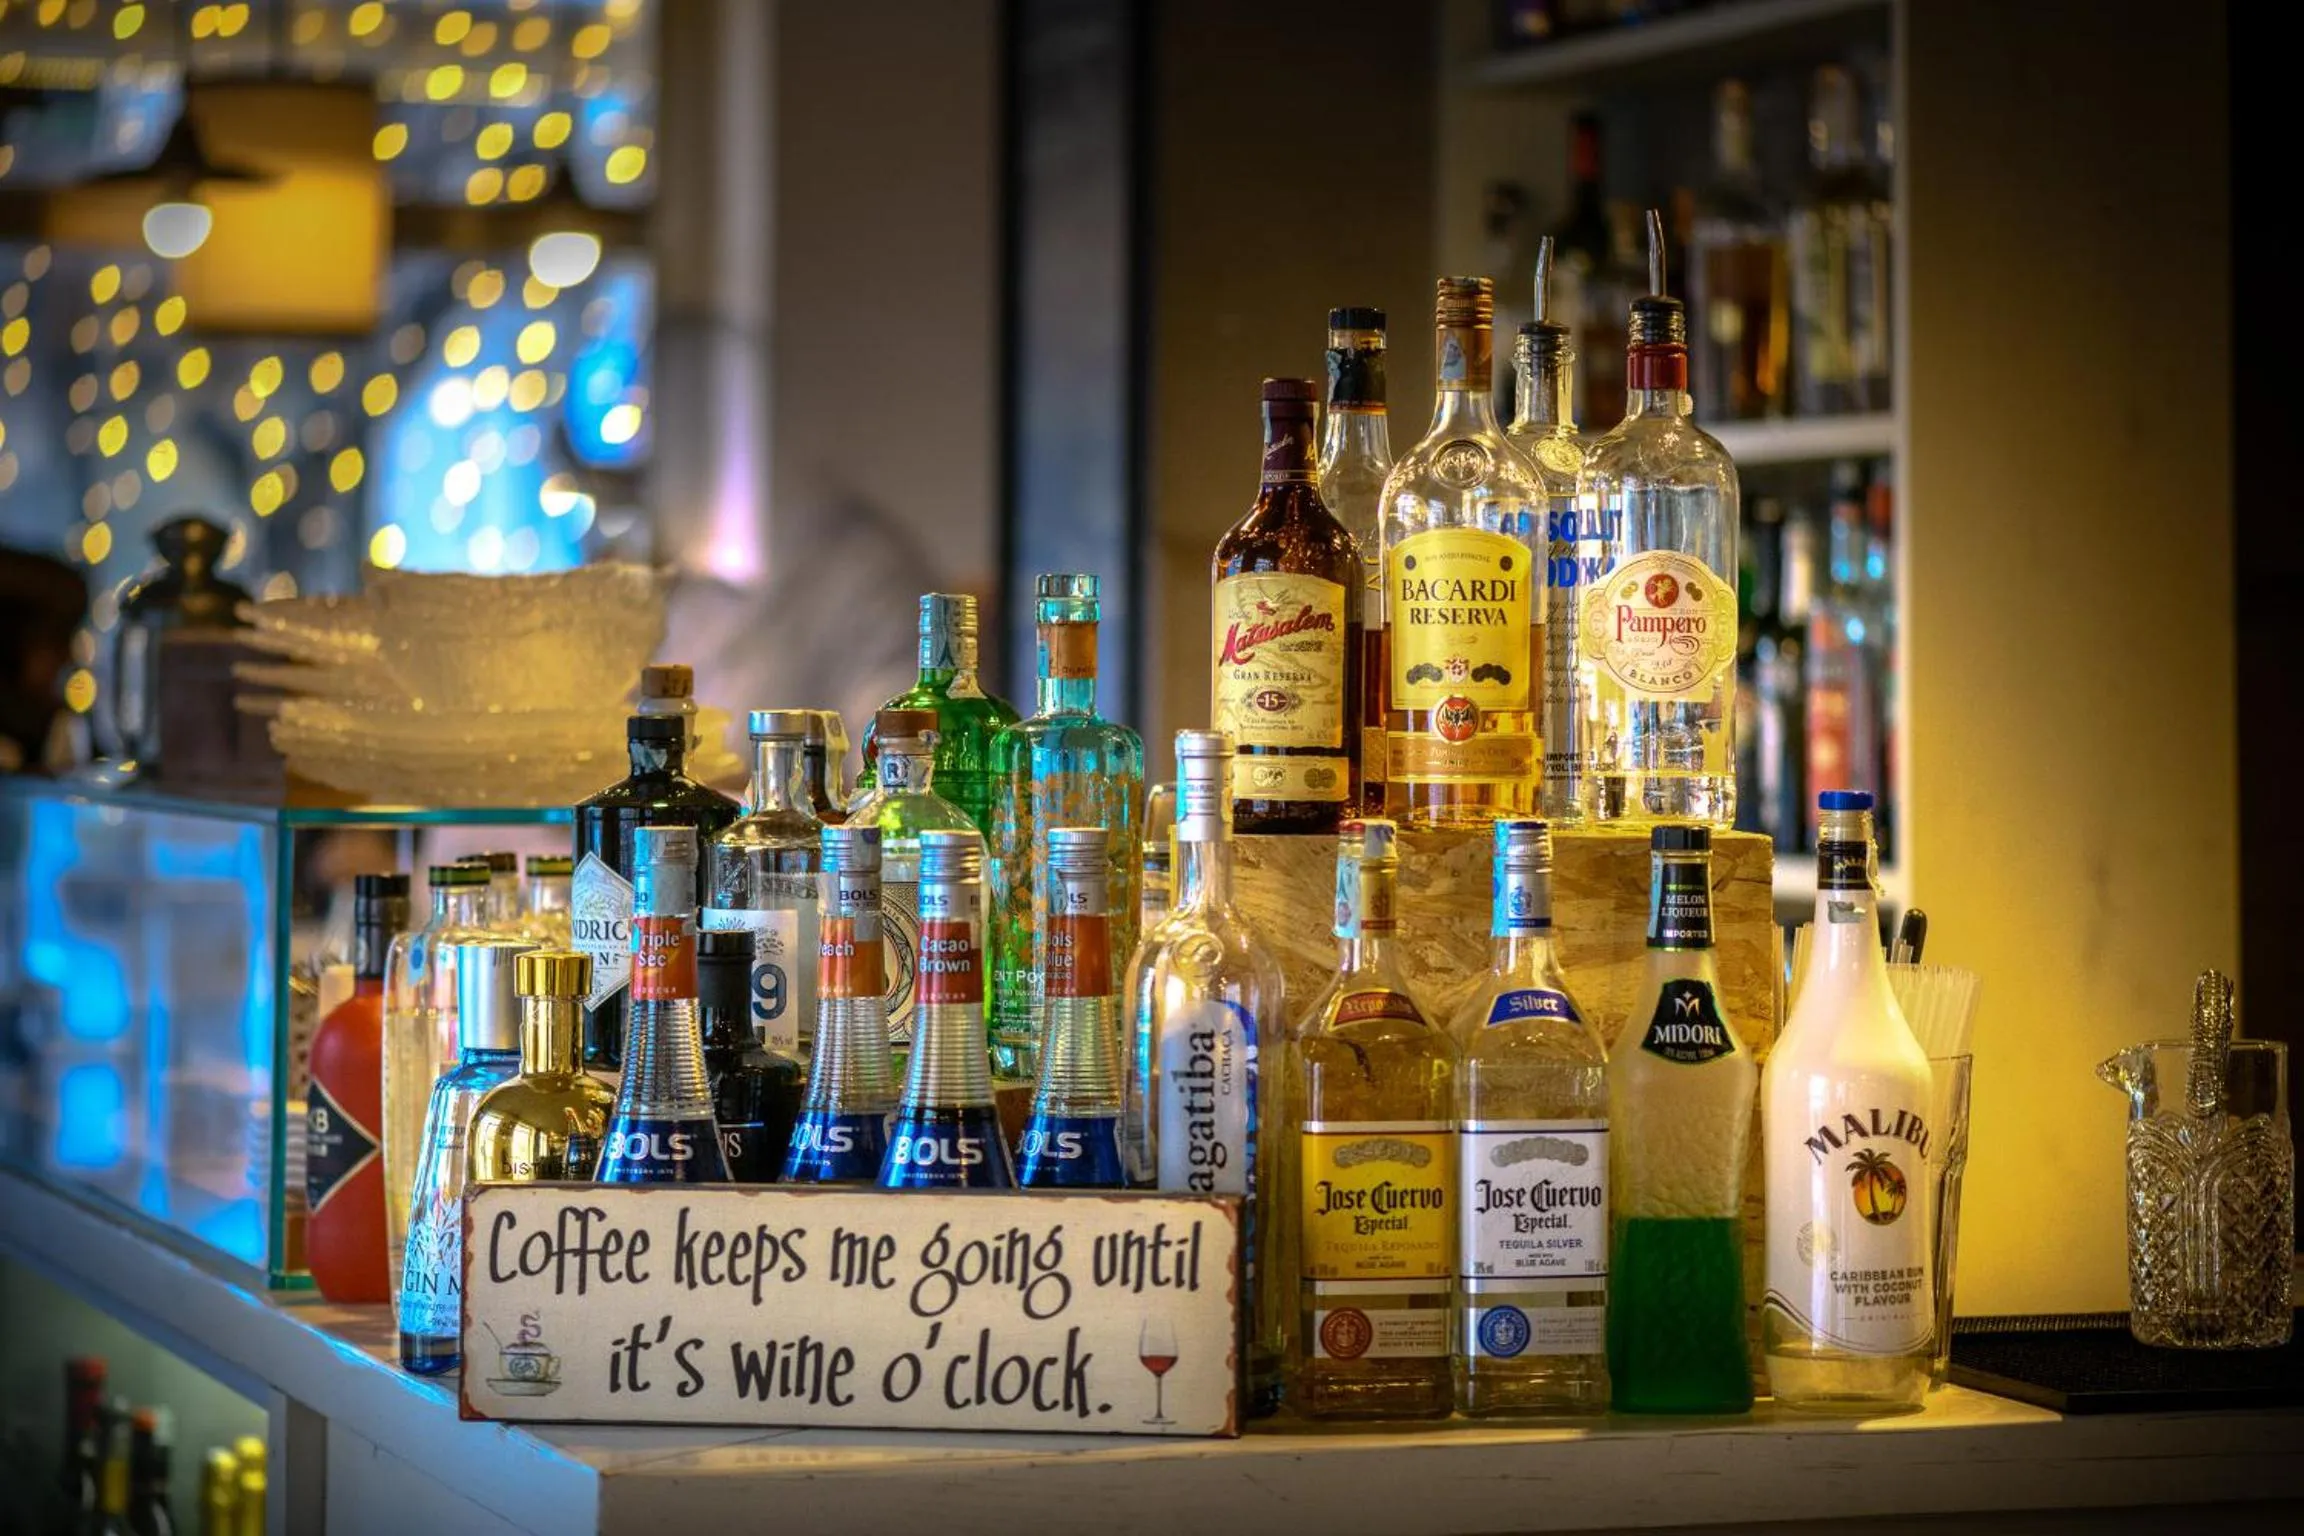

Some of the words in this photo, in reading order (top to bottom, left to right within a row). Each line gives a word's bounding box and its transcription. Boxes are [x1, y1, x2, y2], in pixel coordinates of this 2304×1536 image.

[1402, 579, 1516, 601] BACARDI
[1409, 608, 1508, 625] RESERVA
[1616, 604, 1707, 648] Pampero
[1218, 604, 1336, 667] Matusalem
[1629, 668, 1694, 687] BLANCO
[1264, 692, 1280, 710] 15
[838, 888, 878, 902] BOLS
[1666, 894, 1706, 905] MELON
[639, 930, 681, 949] riple
[920, 936, 969, 953] Cacao
[1048, 931, 1074, 947] ols
[638, 949, 667, 968] Sec
[919, 955, 971, 974] Brown
[1048, 951, 1073, 968] lue
[1508, 993, 1561, 1014] Silver
[1653, 1024, 1722, 1046] MIDORI
[605, 1131, 695, 1162] BOLS
[893, 1135, 984, 1167] BOLS
[1314, 1180, 1367, 1216] Jose
[1371, 1180, 1444, 1215] Cuervo
[1475, 1178, 1527, 1215] Jose
[1530, 1178, 1602, 1213] Cuervo
[1354, 1214, 1409, 1236] Especial
[1512, 1212, 1569, 1234] Especial
[1499, 1240, 1544, 1250] TEQUILA
[1546, 1238, 1584, 1248] SILVER
[488, 1205, 651, 1299] Coffee
[674, 1205, 807, 1306] keeps
[829, 1225, 897, 1291] me
[908, 1220, 1072, 1321] going
[1091, 1220, 1203, 1295] until
[404, 1270, 440, 1296] GIN
[1830, 1268, 1905, 1282] CARIBBEAN
[1834, 1283, 1870, 1295] WITH
[1873, 1278, 1924, 1294] COCONUT
[1854, 1293, 1912, 1307] FLAVOUR
[608, 1314, 706, 1397] it's
[732, 1323, 856, 1410] wine
[881, 1320, 1115, 1419] o'clock.
